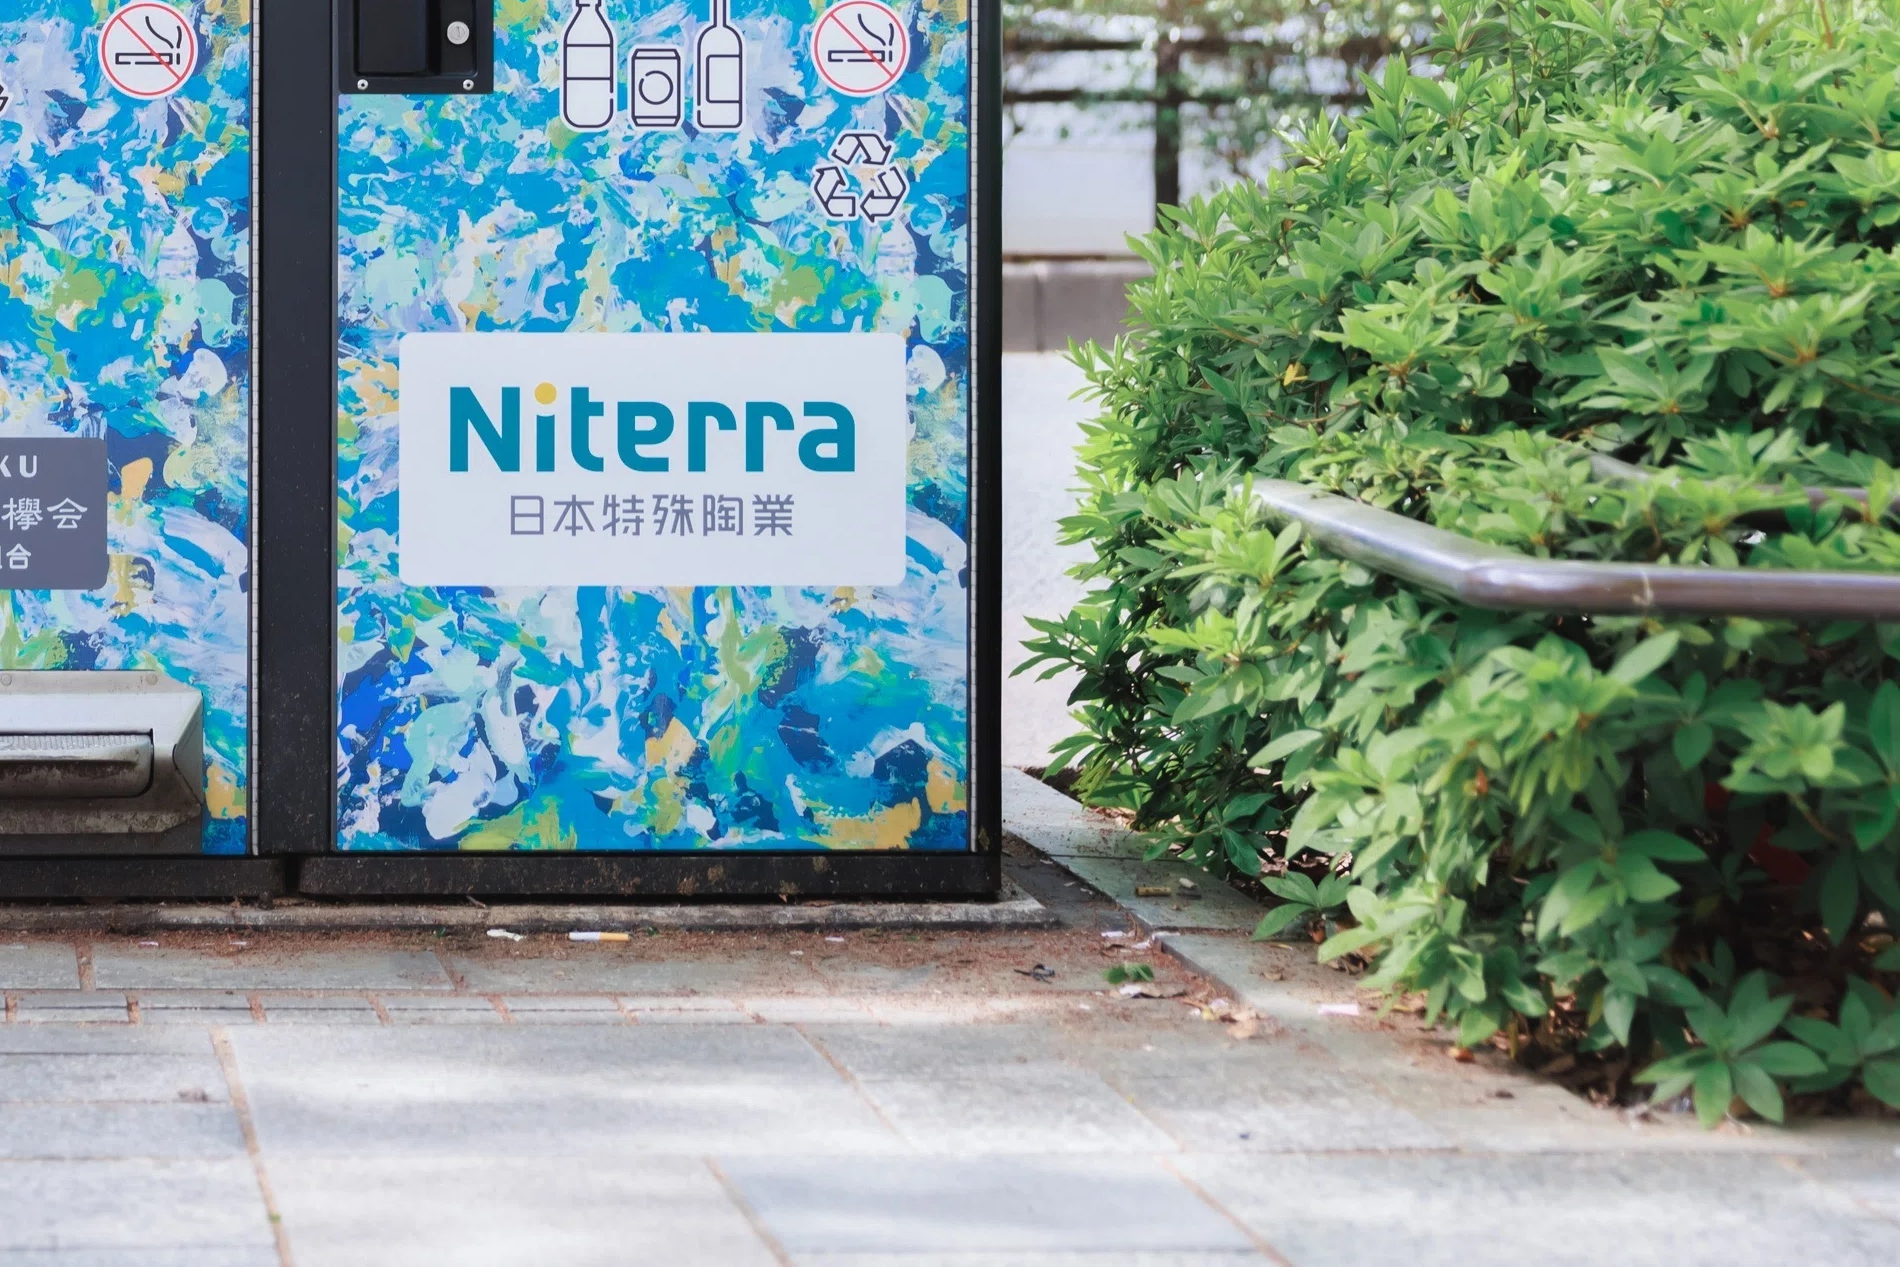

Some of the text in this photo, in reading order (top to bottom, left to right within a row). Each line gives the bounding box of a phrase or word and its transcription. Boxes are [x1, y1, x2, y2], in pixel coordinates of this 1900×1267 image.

[449, 382, 856, 473] Niterra
[509, 493, 795, 537] 日本特殊陶業
